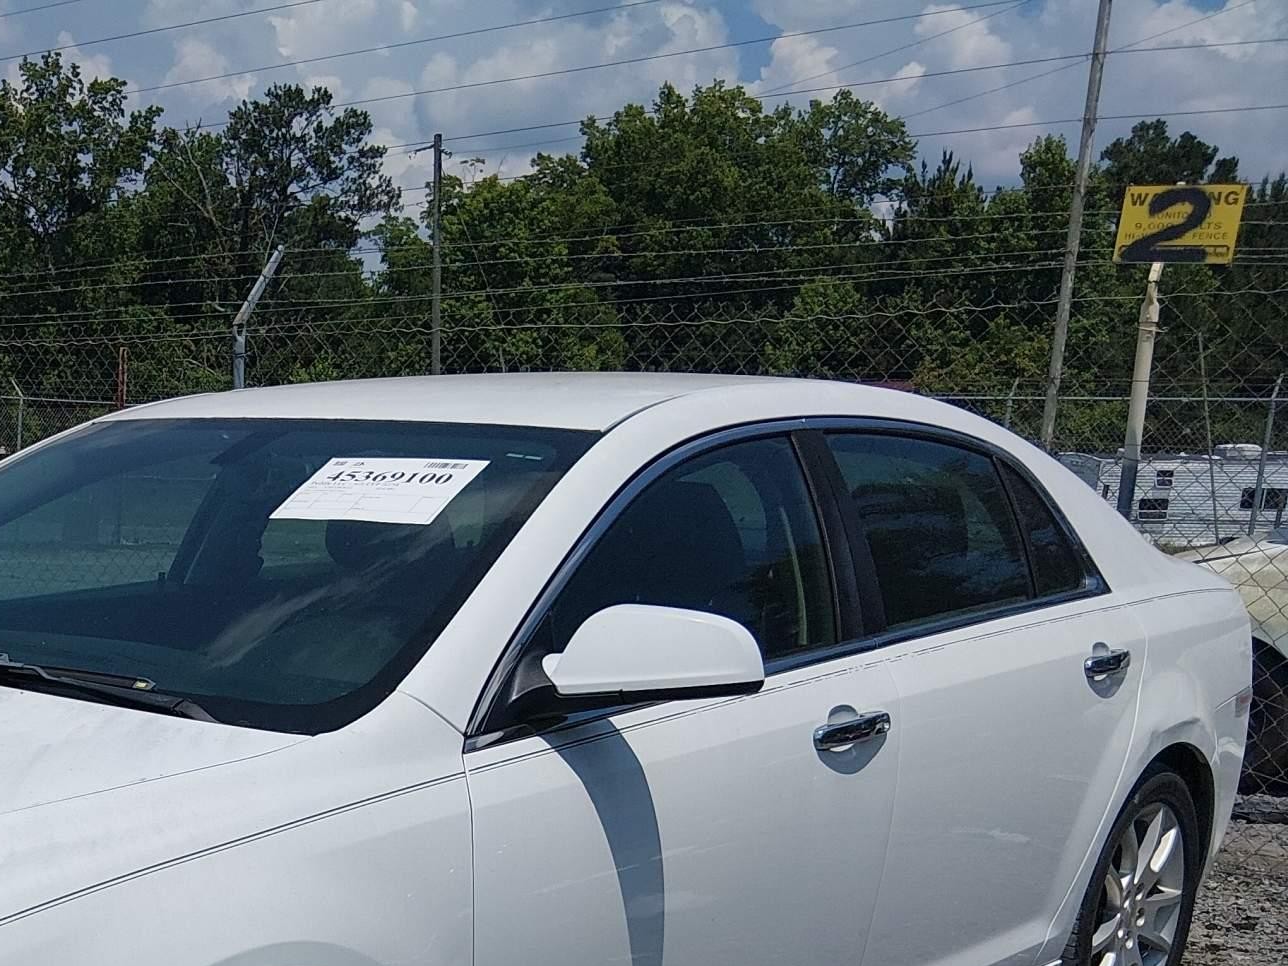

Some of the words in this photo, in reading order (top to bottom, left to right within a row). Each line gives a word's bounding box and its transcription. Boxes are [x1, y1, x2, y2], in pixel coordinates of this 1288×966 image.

[1119, 188, 1211, 262] 2
[1193, 232, 1230, 240] FENCE
[326, 470, 454, 485] 45369100
